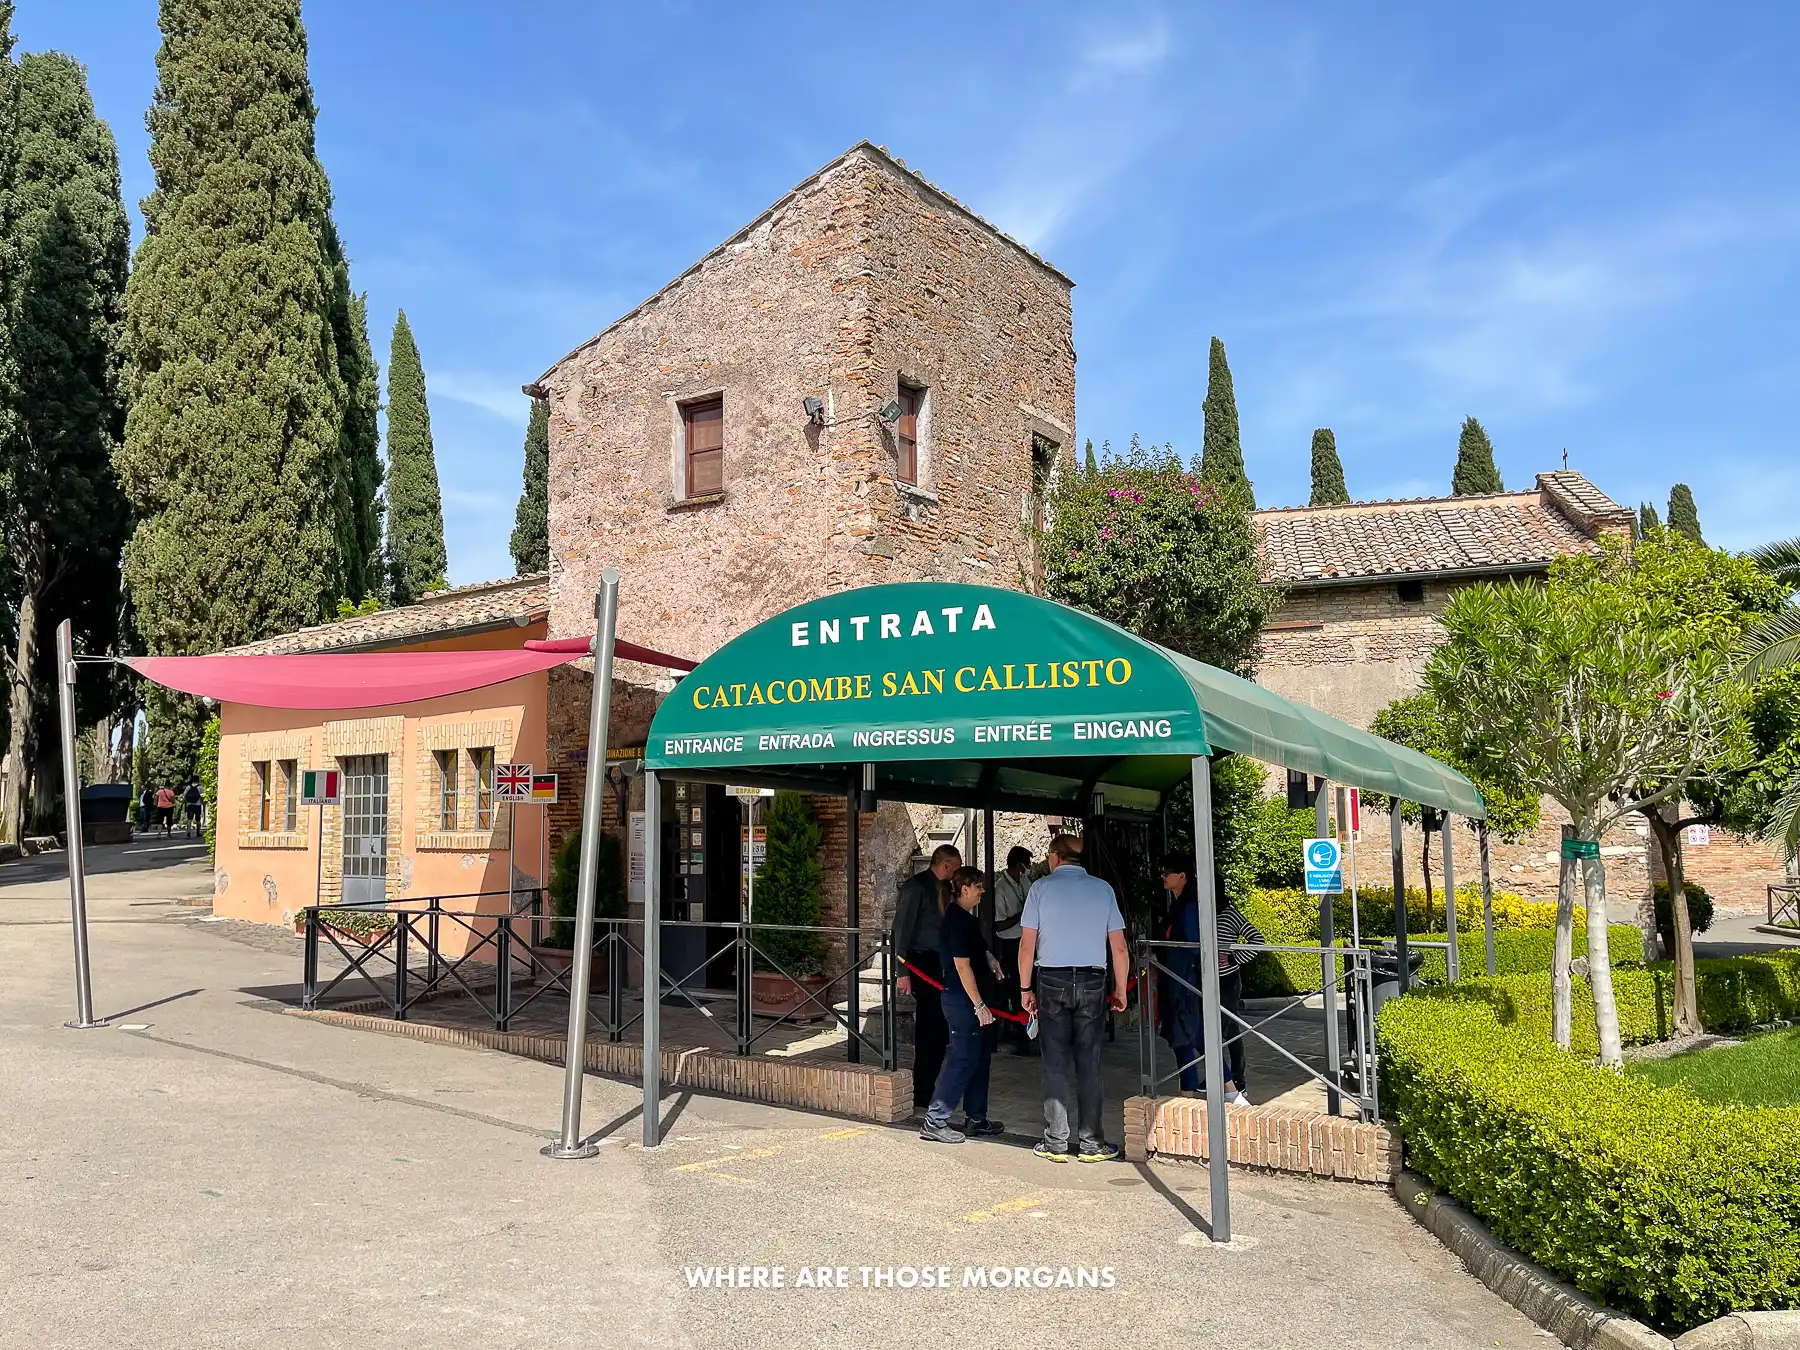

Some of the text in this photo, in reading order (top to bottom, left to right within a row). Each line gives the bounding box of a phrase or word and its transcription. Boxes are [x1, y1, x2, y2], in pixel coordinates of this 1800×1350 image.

[791, 604, 997, 647] ENTRATA
[692, 658, 1132, 710] CATACOMBE SAN CALLISTO
[664, 718, 1172, 755] ENTRANCE ENTRADA INGRESSUS ENTRÉE EINGANG
